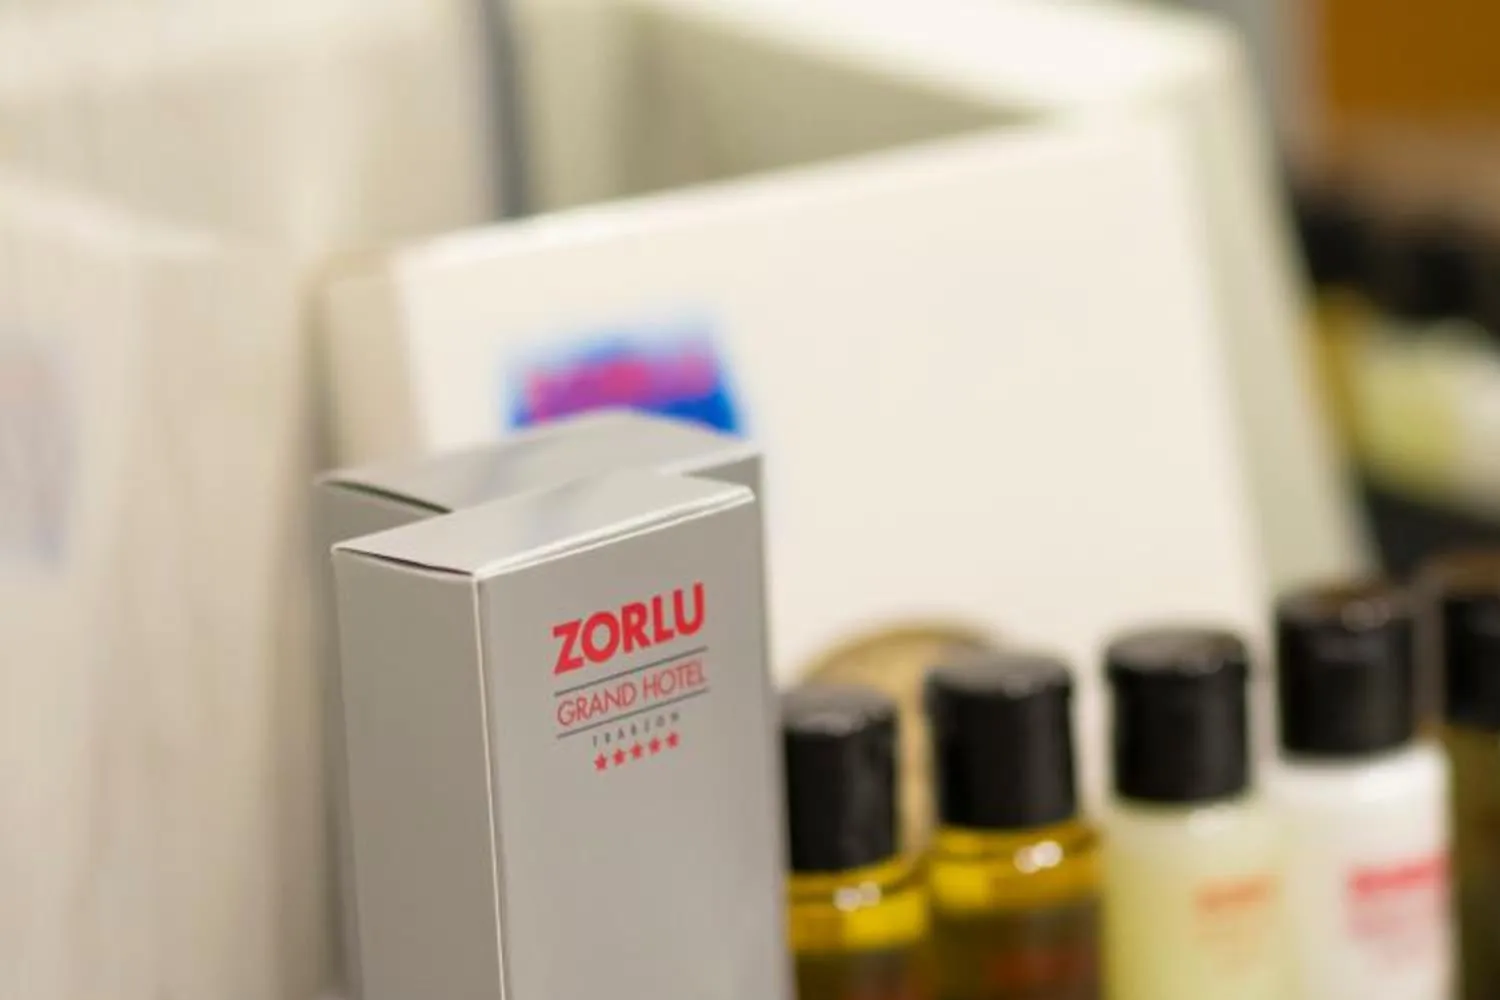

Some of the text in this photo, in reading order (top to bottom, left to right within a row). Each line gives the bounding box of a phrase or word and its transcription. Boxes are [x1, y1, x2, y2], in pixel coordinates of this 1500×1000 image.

[552, 582, 705, 675] ZORLU
[557, 659, 708, 727] GRAND HOTEL
